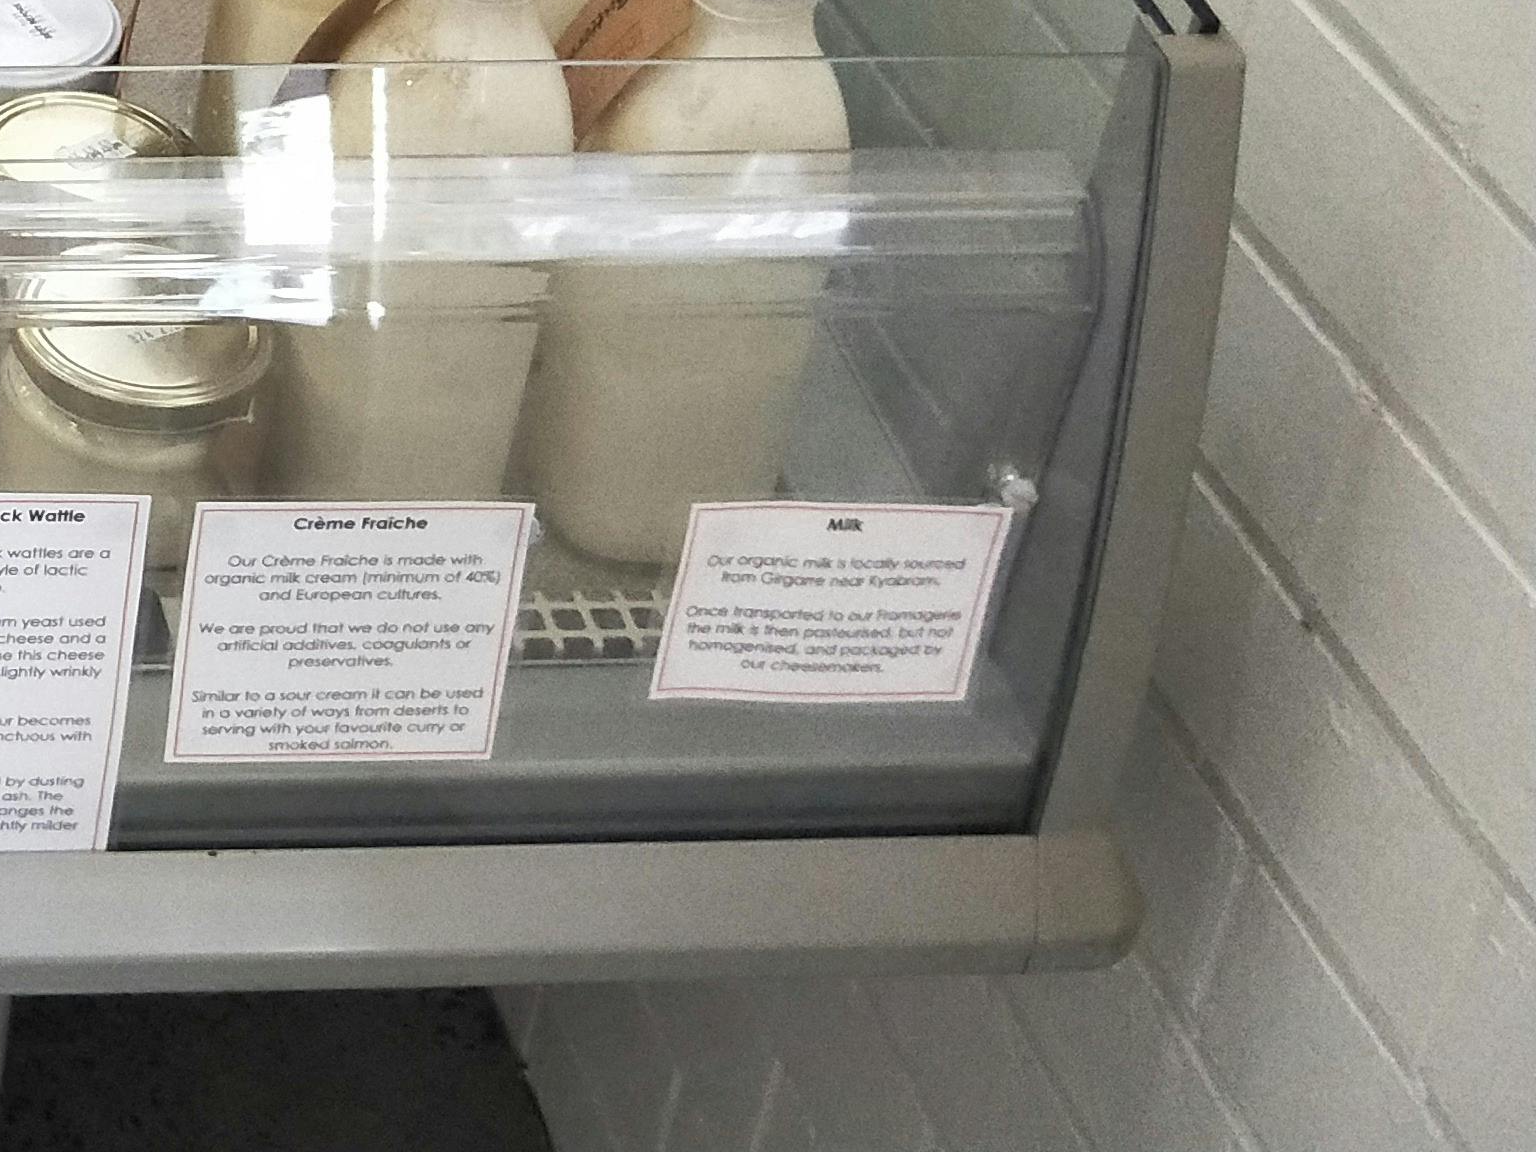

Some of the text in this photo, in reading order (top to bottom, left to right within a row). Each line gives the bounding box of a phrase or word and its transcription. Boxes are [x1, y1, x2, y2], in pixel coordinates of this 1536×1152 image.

[28, 508, 86, 523] Wattle
[293, 515, 428, 530] Crème Fraîche
[826, 515, 863, 533] Milk
[227, 552, 486, 569] Our Crème Fraîche is made with
[22, 562, 40, 576] of
[42, 563, 89, 576] lactic
